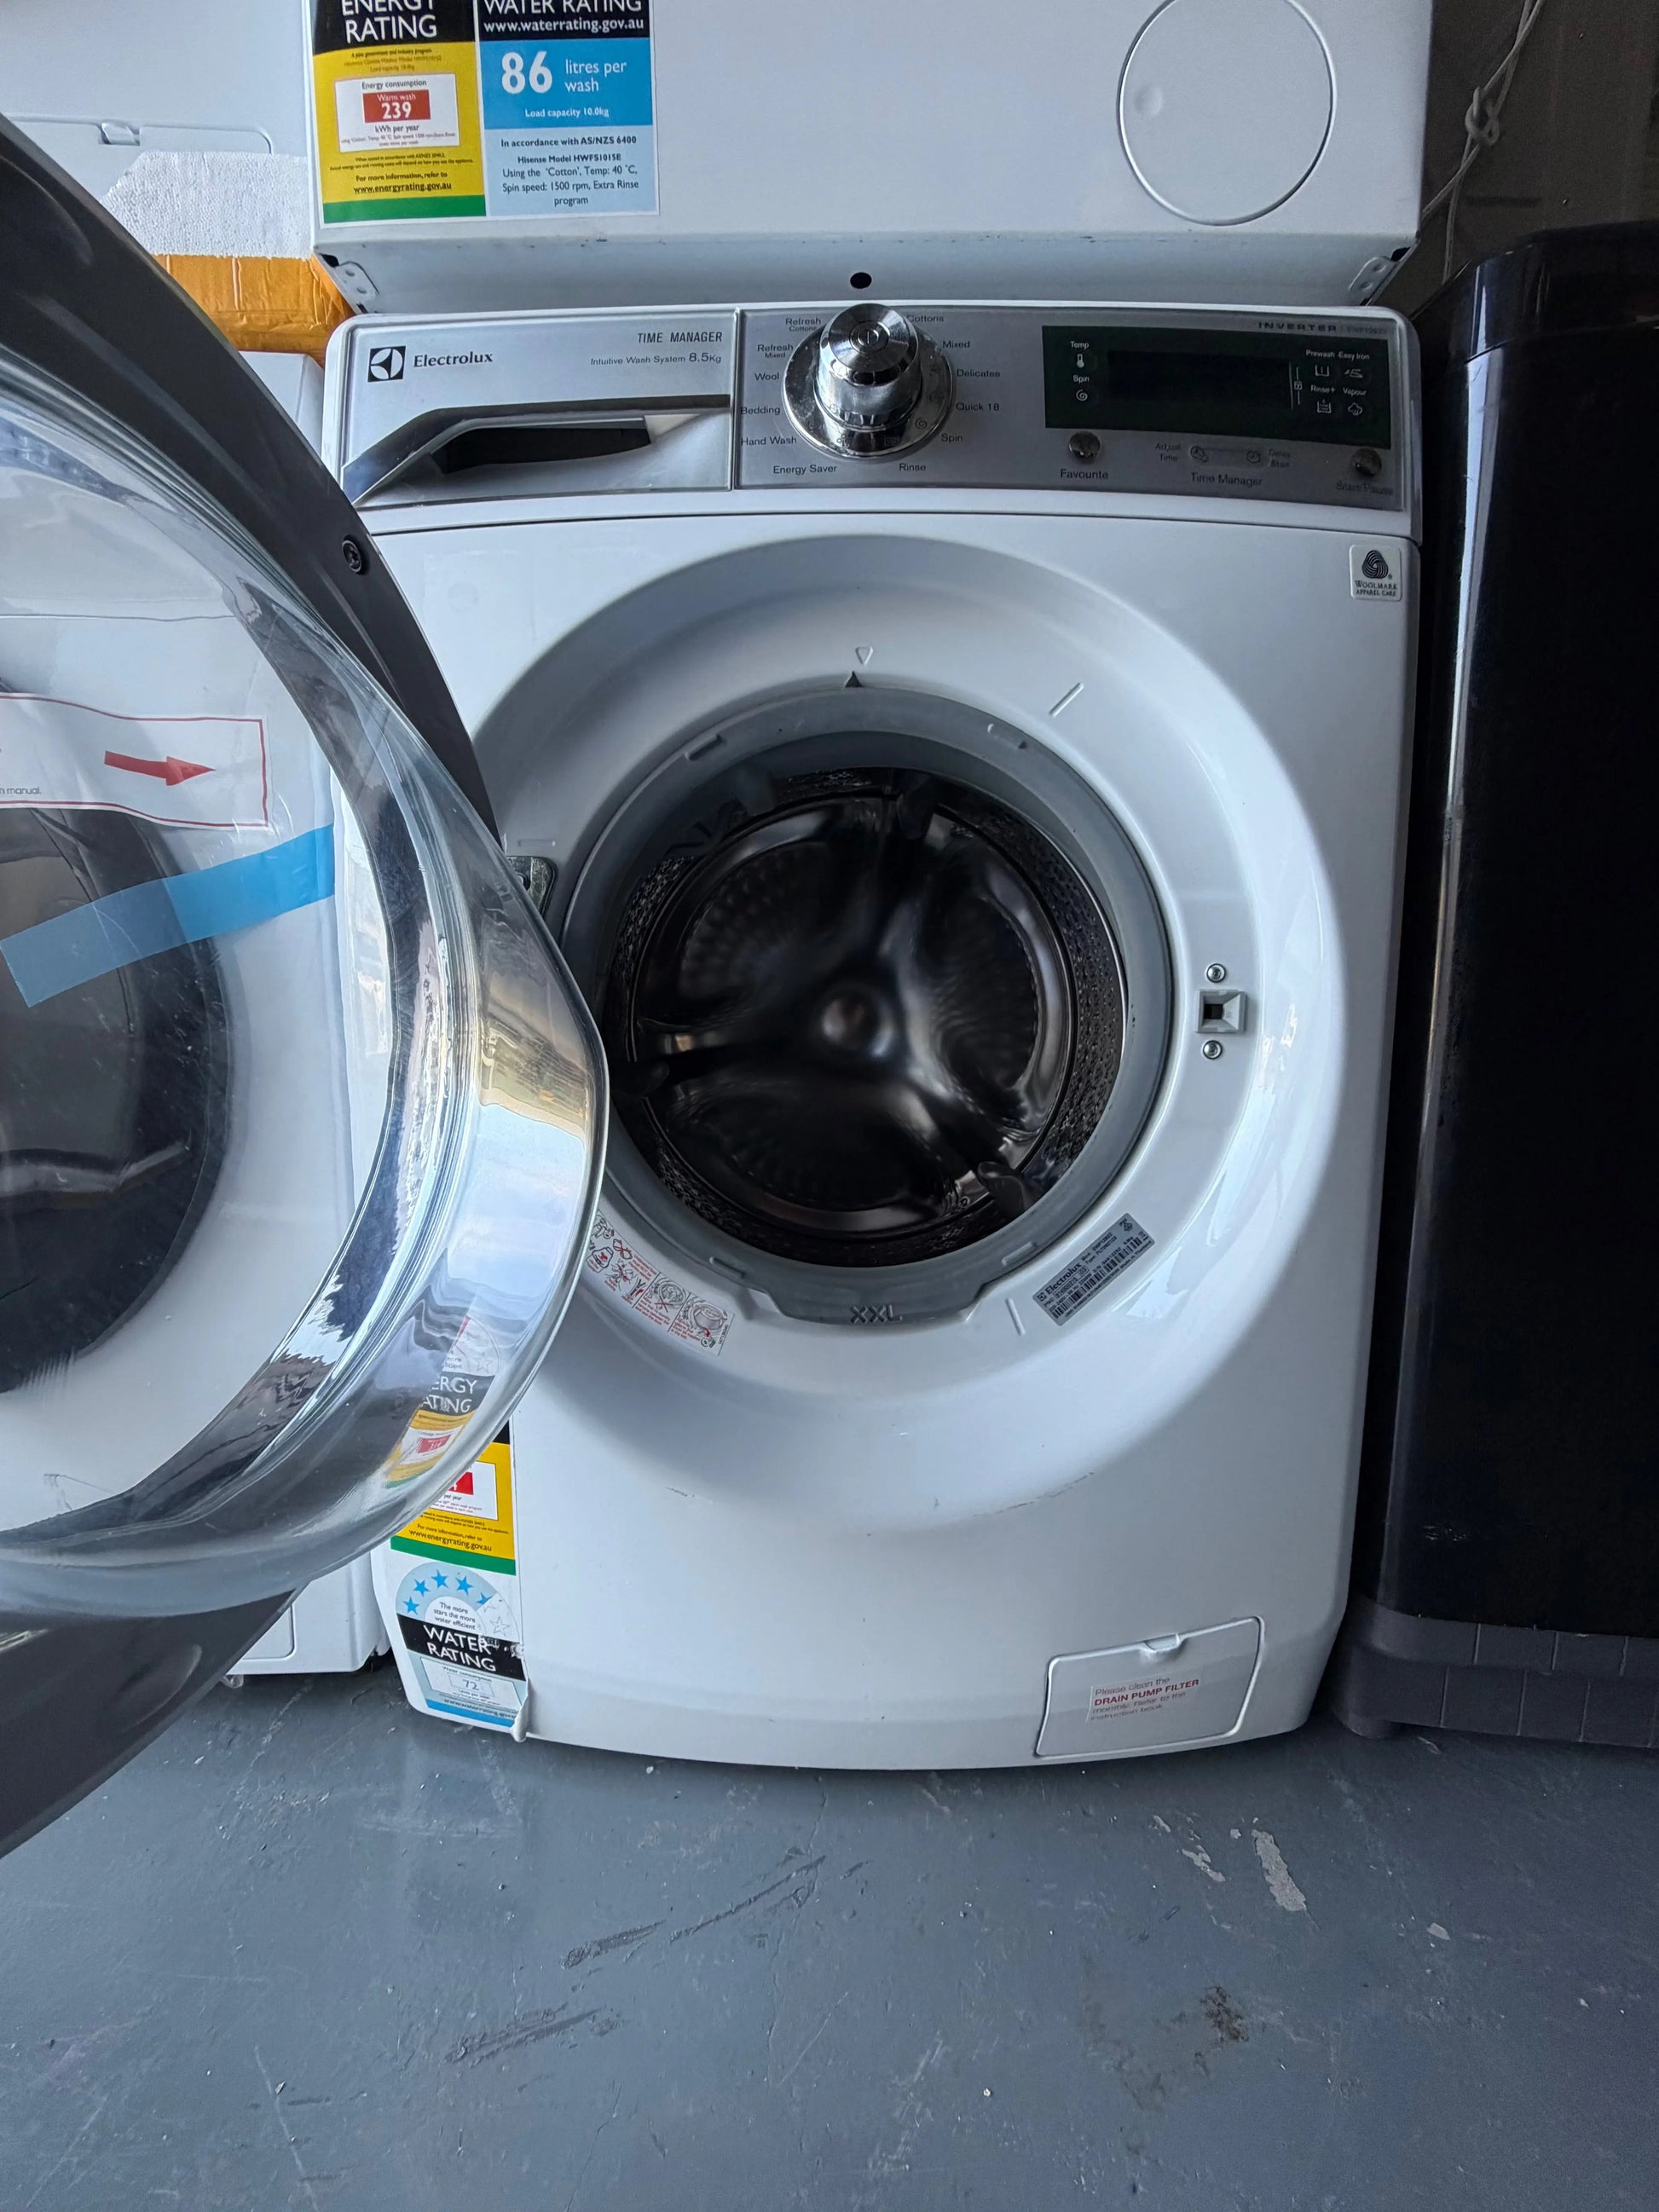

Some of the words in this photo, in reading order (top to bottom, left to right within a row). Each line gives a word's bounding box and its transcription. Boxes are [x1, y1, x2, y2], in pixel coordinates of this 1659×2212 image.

[483, 0, 555, 14] WATER
[563, 0, 642, 13] RATING
[345, 14, 436, 43] RATING
[483, 17, 644, 33] www.waterrating.gov.au
[501, 50, 553, 95] 86
[565, 59, 599, 74] litres
[604, 61, 627, 78] per
[385, 79, 427, 89] consumption
[564, 78, 599, 92] wash
[400, 92, 416, 101] wash
[382, 101, 412, 119] 239
[525, 109, 546, 118] Load
[547, 107, 581, 118] capacity
[583, 107, 610, 117] 10.0kg
[375, 124, 391, 133] kWh
[501, 139, 509, 147] In
[511, 137, 559, 147] accordance
[560, 137, 579, 146] with
[581, 136, 615, 145] AS/NZS
[616, 136, 637, 144] 6400
[517, 155, 546, 164] Hisense
[502, 169, 526, 179] Using
[528, 168, 540, 177] the
[584, 166, 610, 176] Temp:
[612, 166, 622, 175] 40
[354, 182, 451, 194] www.energyrating.gov.au
[502, 183, 519, 193] Spin
[522, 182, 547, 193] speed:
[551, 182, 569, 191] 1500
[572, 182, 591, 193] rpm,
[593, 181, 615, 189] Extra
[616, 180, 639, 188] Rinse
[554, 196, 588, 207] program
[1258, 321, 1337, 332] INVERTER
[638, 332, 662, 344] TIME
[669, 331, 723, 343] MANAGER
[757, 344, 794, 352] Refresh
[1070, 340, 1090, 350] Temp
[413, 350, 494, 368] Electrolux
[591, 357, 623, 366] Intuitive
[653, 356, 685, 365] System
[754, 373, 779, 381] Wool
[1072, 374, 1090, 384] Spin
[1343, 387, 1367, 396] Vapour
[741, 407, 781, 415] Bedding
[956, 402, 984, 411] Quick
[741, 437, 766, 446] Hand
[769, 436, 797, 445] Wash
[941, 433, 962, 443] Spin
[773, 465, 806, 475] Energy
[809, 465, 837, 473] Saver
[1060, 468, 1108, 480] Favourite
[1191, 472, 1215, 482] Time
[1218, 474, 1263, 488] Manager
[1355, 580, 1397, 590] WOOLMARK
[1045, 1262, 1082, 1296] Electrolux
[850, 1304, 903, 1323] XXL
[440, 1602, 451, 1610] The
[452, 1606, 468, 1614] more
[433, 1608, 448, 1617] stars
[460, 1614, 476, 1623] more
[435, 1615, 451, 1625] water
[452, 1620, 476, 1630] efficient
[423, 1625, 492, 1655] WATER
[426, 1642, 497, 1672] RATING
[462, 1678, 479, 1690] 72
[1095, 1686, 1126, 1696] Please
[1155, 1677, 1171, 1685] the
[1095, 1695, 1129, 1706] DRAIN
[1131, 1688, 1162, 1700] PUMP
[1165, 1679, 1199, 1693] FILTER
